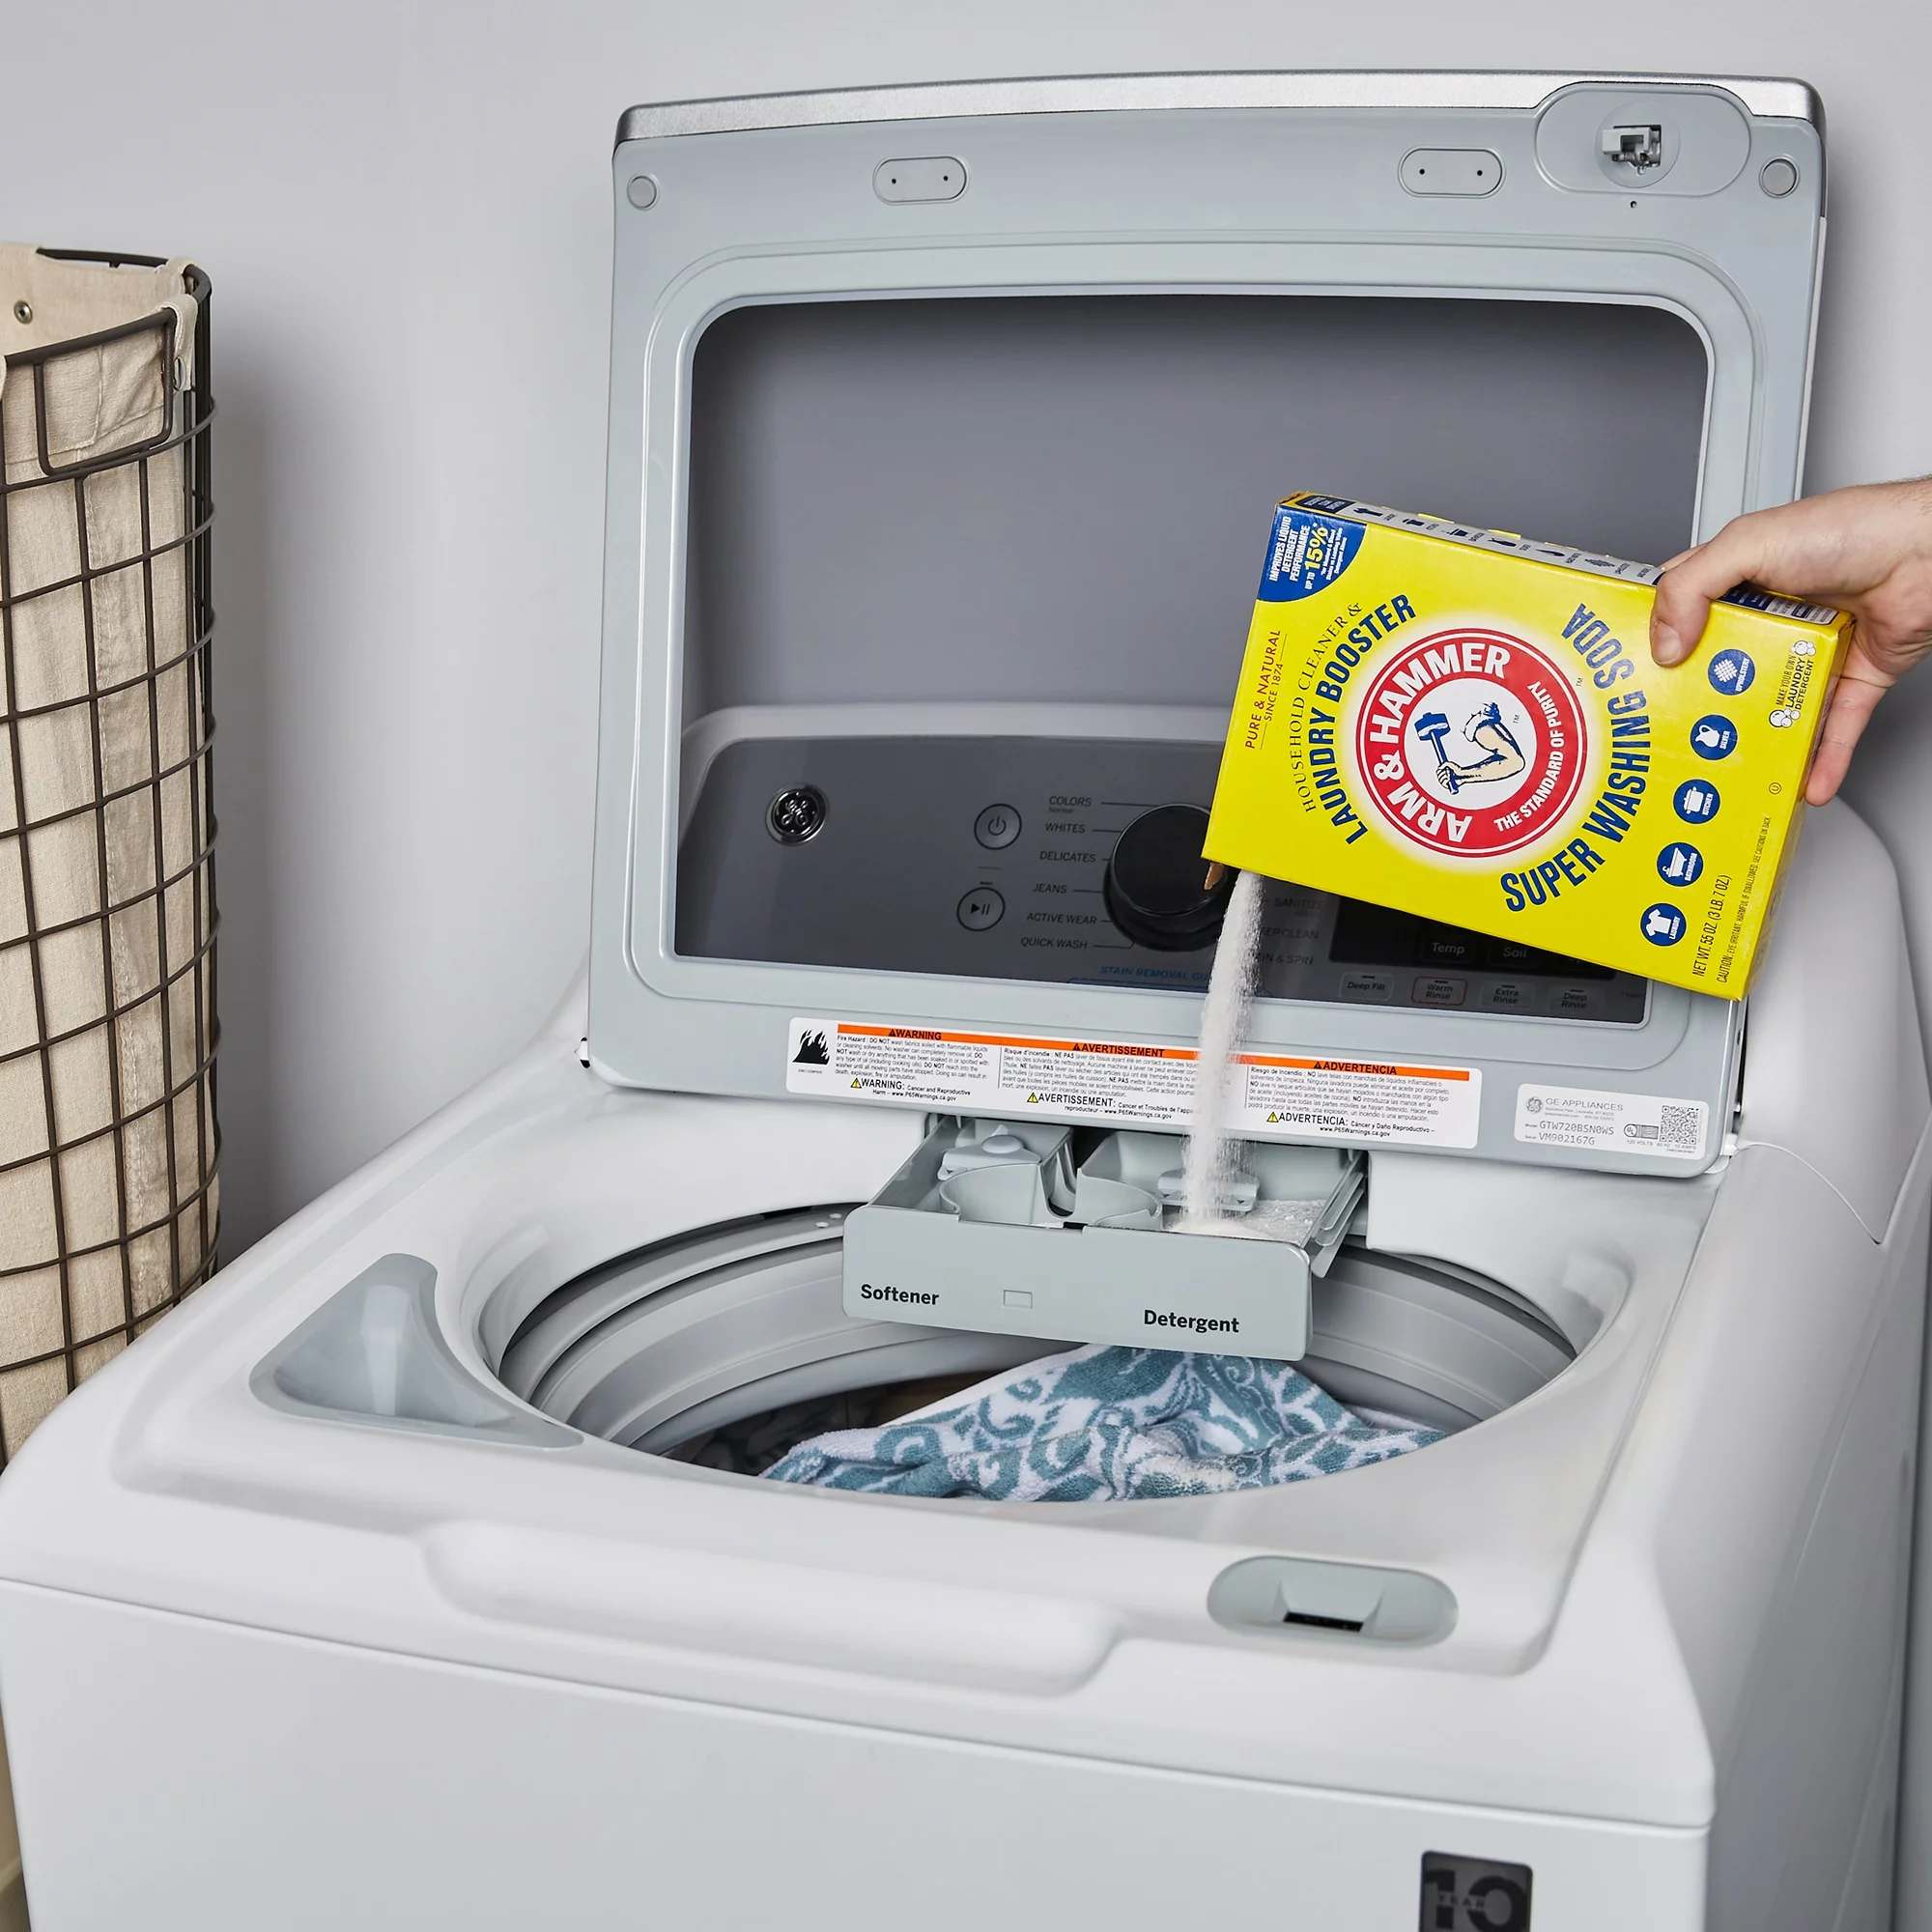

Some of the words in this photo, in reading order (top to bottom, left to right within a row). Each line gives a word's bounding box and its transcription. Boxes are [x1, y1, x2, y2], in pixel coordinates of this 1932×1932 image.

[1269, 542, 1286, 582] IMPROVES
[1278, 516, 1292, 542] LIQUID
[1281, 529, 1298, 573] DETERGENT
[1290, 526, 1310, 582] PERFORMANCE
[1332, 542, 1341, 559] Leading
[1334, 551, 1344, 574] Detergent
[1305, 580, 1313, 589] UP
[1349, 602, 1364, 617] &
[1297, 615, 1349, 691] CLEANER
[1315, 593, 1416, 703] BOOSTER
[1561, 603, 1634, 690] SODA
[1257, 630, 1281, 696] NATURAL
[1785, 655, 1797, 670] OWN
[1735, 657, 1750, 692] UPHOLSTERY
[1781, 670, 1792, 688] YOUR
[1785, 657, 1806, 707] LAUNDRY
[1264, 693, 1279, 722] SINCE
[1272, 663, 1284, 685] 1874
[1795, 659, 1814, 710] DETERGENT
[1369, 642, 1512, 744] HAMMER
[1776, 688, 1788, 706] MAKE
[1254, 700, 1264, 710] &
[1527, 680, 1563, 726] PURITY
[1245, 715, 1262, 750] PURE
[1549, 732, 1565, 748] OF
[1719, 730, 1730, 750] SILVER
[1290, 696, 1316, 812] HOUSEHOLD
[1373, 751, 1405, 781] &
[1581, 690, 1651, 842] WASHING
[1308, 706, 1368, 845] LAUNDRY
[1520, 750, 1564, 817] STANDARD
[1049, 796, 1092, 807] COLORS
[1702, 793, 1714, 816] KITCHEN
[1387, 784, 1473, 842] ARM
[1045, 823, 1086, 833] WHITES
[1493, 813, 1522, 832] THE
[1039, 850, 1095, 863] DELICATES
[1685, 852, 1698, 881] BATHROOM
[1500, 838, 1605, 912] SUPER
[1033, 883, 1067, 894] JEANS
[1274, 898, 1325, 909] SANITIZE
[1710, 898, 1725, 911] LB.
[1717, 953, 1734, 983] CAUTION:
[1727, 944, 1737, 954] EYE
[1737, 900, 1748, 922] HARMFUL
[1754, 835, 1766, 854] CAUTIONS
[1027, 913, 1063, 923] ACTIVE
[1066, 915, 1097, 924] WEAR
[1708, 912, 1721, 921] (3
[1282, 929, 1320, 939] CLEAN
[1669, 916, 1681, 939] LAUNDRY
[1703, 922, 1718, 935] OZ.
[1021, 937, 1055, 948] QUICK
[1057, 939, 1088, 950] WASH
[1700, 934, 1714, 945] 55
[1432, 942, 1464, 955] Temp
[1503, 947, 1526, 958] Soil
[1696, 945, 1711, 961] WT.
[1276, 954, 1283, 964] &
[1287, 954, 1314, 964] SPIN
[1100, 966, 1132, 976] STAIN
[1136, 969, 1187, 980] REMOVAL
[1692, 961, 1706, 977] NET
[1348, 981, 1371, 993] Deep
[1372, 982, 1385, 991] Fill
[1428, 983, 1453, 993] Warm
[1495, 988, 1519, 997] Extra
[1426, 991, 1451, 1001] Rinse
[1493, 996, 1519, 1005] Rinse
[1564, 992, 1588, 1003] Deep
[1562, 1001, 1586, 1010] Rinse
[895, 1029, 941, 1040] WARNING
[1082, 1043, 1165, 1057] AVERTISSEMENT
[1323, 1062, 1397, 1074] ADVERTENCIA
[862, 1078, 905, 1090] WARNING:
[893, 1091, 956, 1101] www.P65Warnings.ca.gov
[1038, 1093, 1116, 1107] AVERTISSEMENT:
[1546, 1097, 1561, 1106] GE
[1563, 1099, 1623, 1111] APPLIANCES
[1105, 1109, 1172, 1119] www.P65Warnings.ca.gov
[1279, 1112, 1349, 1126] ADVERTENCIA:
[1392, 1124, 1430, 1133] Reproductivo
[1320, 1126, 1390, 1137] www.P65Warnings.ca.gov
[1539, 1132, 1596, 1146] VM902167G
[860, 1283, 939, 1307] Softener
[1144, 1309, 1240, 1334] Detergent
[1425, 1868, 1528, 1932] 10
[1437, 1893, 1486, 1909] YEAR
